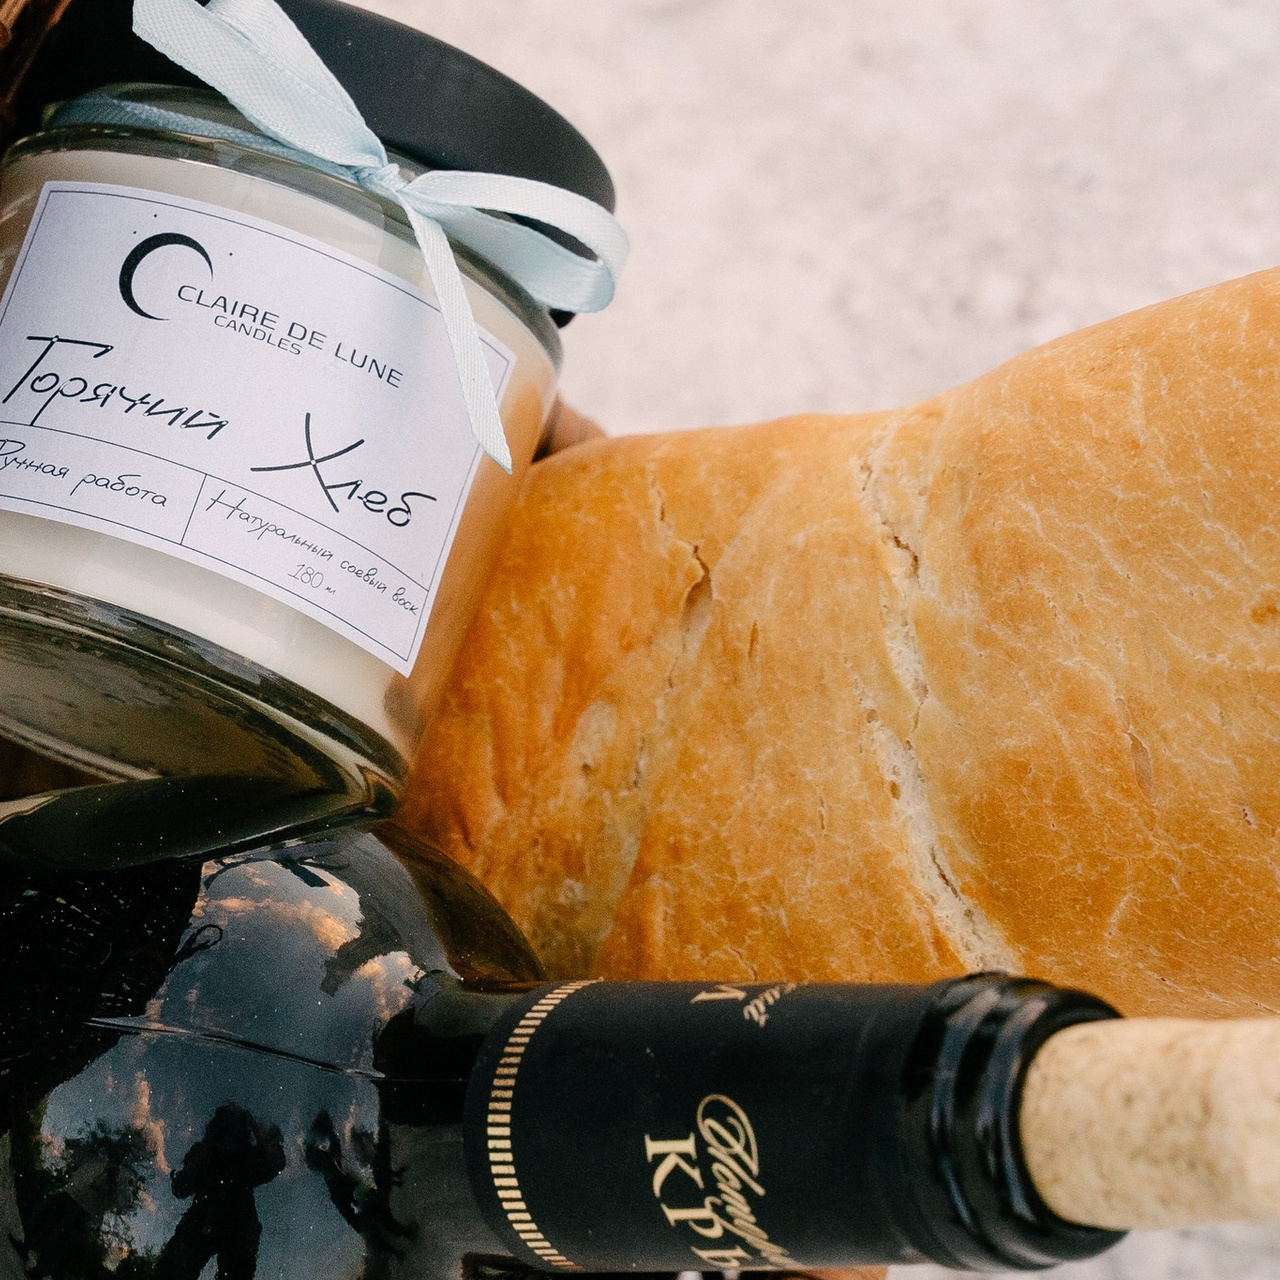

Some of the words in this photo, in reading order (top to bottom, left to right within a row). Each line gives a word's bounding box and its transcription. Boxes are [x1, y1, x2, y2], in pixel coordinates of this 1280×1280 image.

[176, 284, 280, 331] CLAIRE
[287, 321, 328, 351] DE
[334, 341, 404, 389] LUNE
[213, 314, 303, 356] CANDLES
[2, 334, 230, 440] Горячий
[250, 412, 438, 528] Хлеб
[69, 473, 168, 508] работа
[205, 489, 334, 562] Натуральный
[339, 559, 388, 595] соевый
[391, 586, 420, 616] воск
[287, 563, 325, 590] 180
